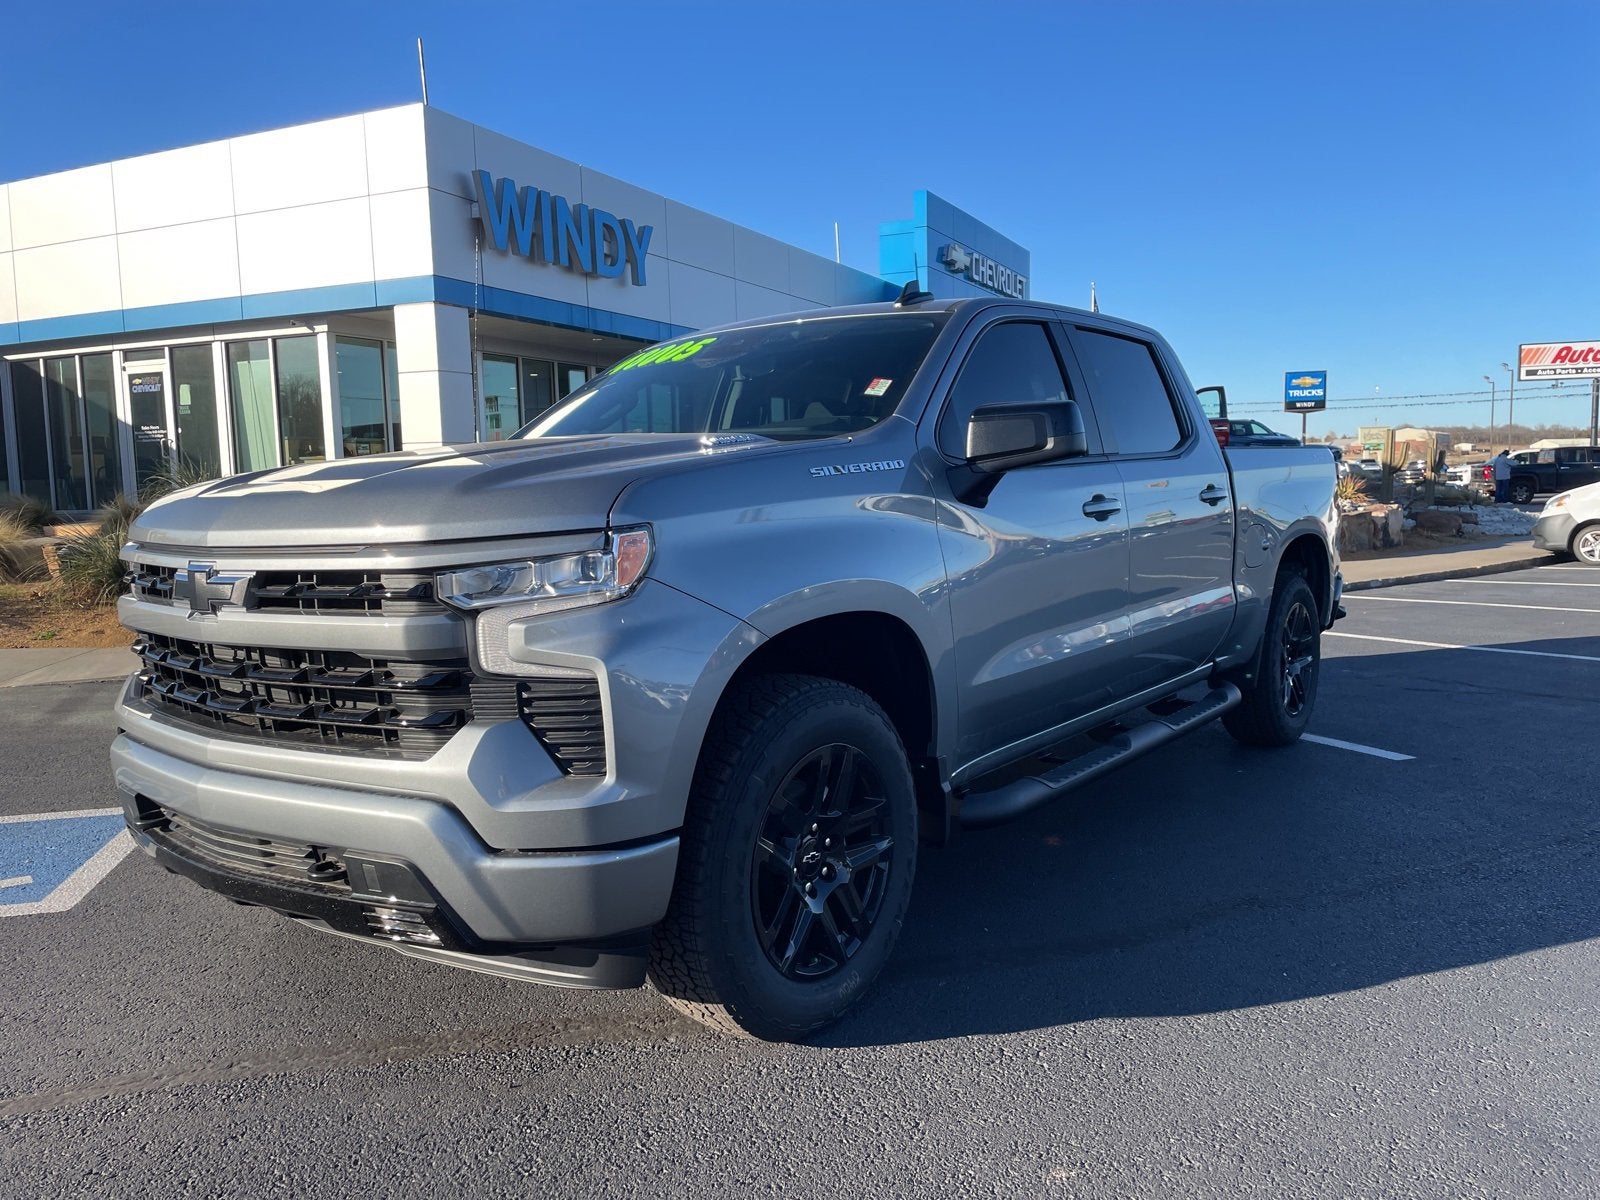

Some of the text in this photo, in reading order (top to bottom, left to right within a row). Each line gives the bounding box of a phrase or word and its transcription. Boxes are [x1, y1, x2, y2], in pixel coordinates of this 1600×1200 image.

[472, 169, 653, 286] WINDY
[972, 252, 1027, 299] CHEVROLET
[1288, 388, 1324, 397] TRUCKS
[809, 459, 905, 478] SILVERADO
